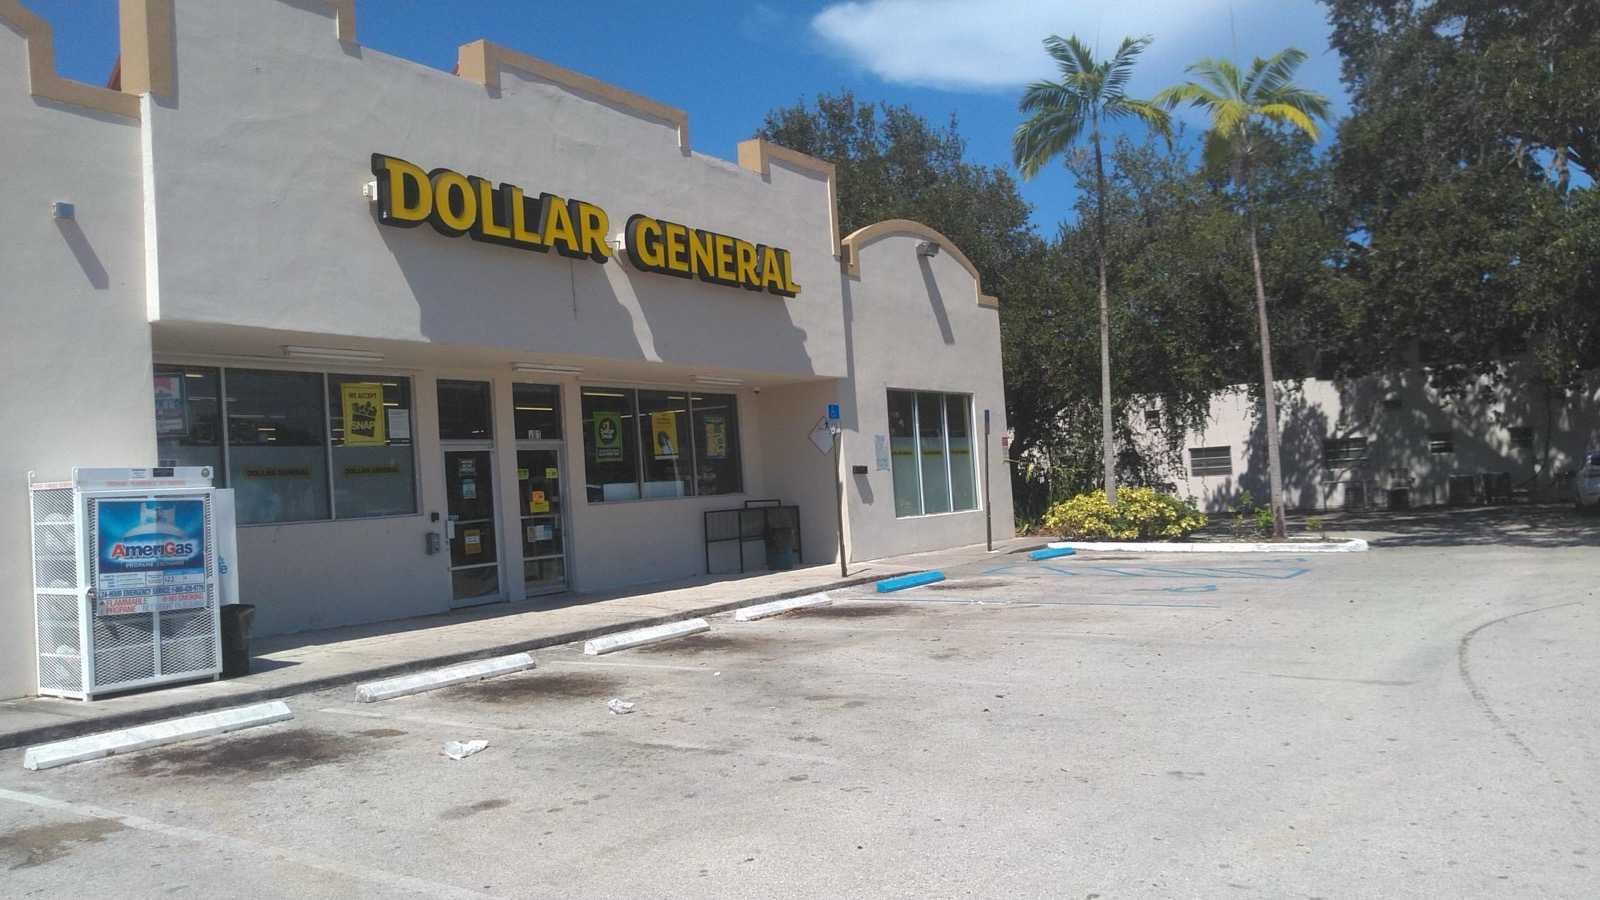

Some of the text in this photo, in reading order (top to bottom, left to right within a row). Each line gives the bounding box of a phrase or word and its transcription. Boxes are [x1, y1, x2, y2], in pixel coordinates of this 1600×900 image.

[380, 155, 802, 294] DOLLAR GENERAL
[351, 420, 376, 430] SNAP
[111, 541, 193, 558] AmeriGas
[123, 588, 150, 596] EMERGENCY
[177, 593, 204, 601] SMOKING
[106, 597, 148, 607] FLAMMABLE
[106, 605, 136, 614] PROPANE
